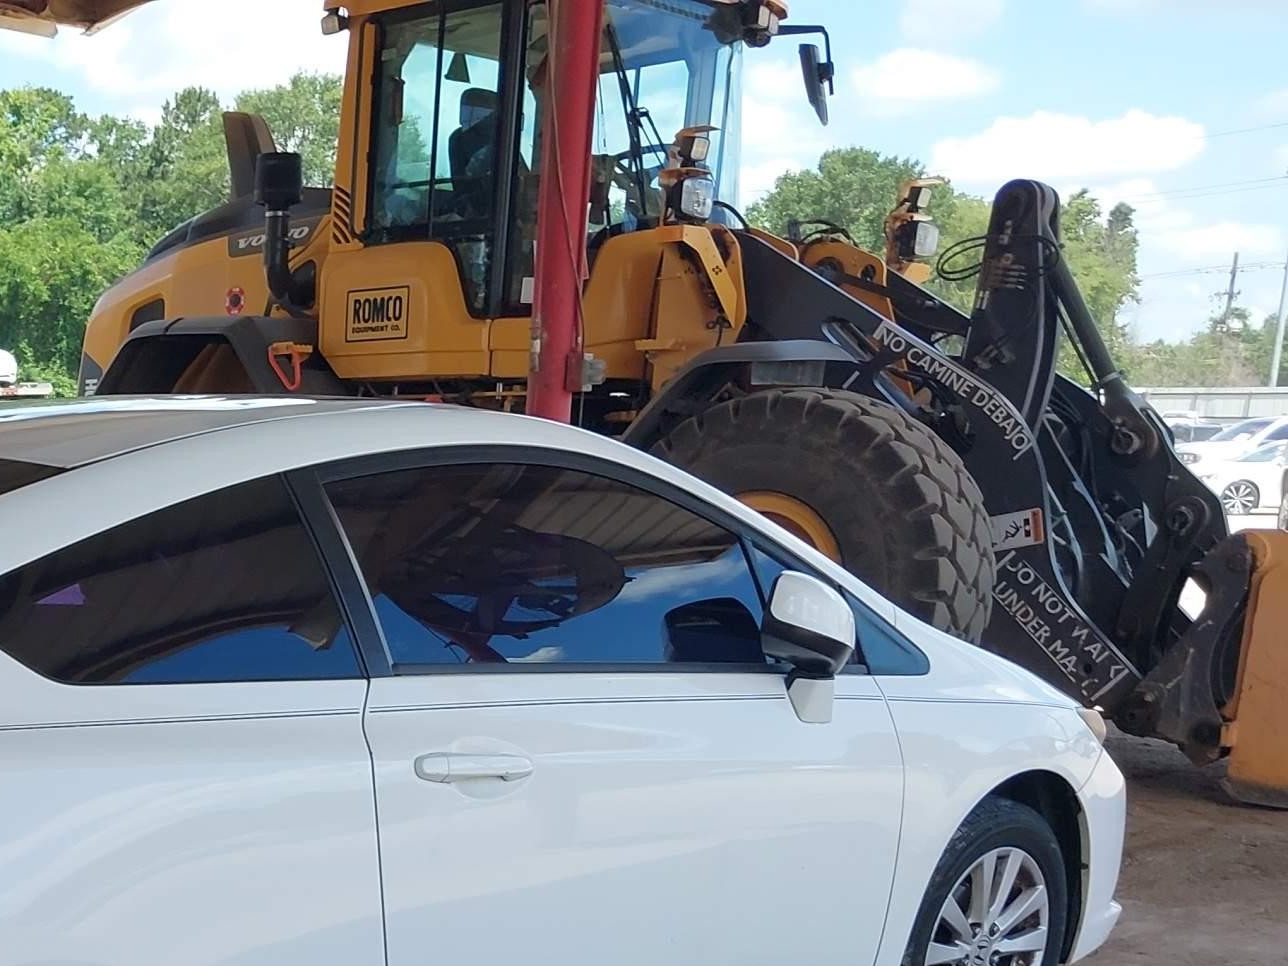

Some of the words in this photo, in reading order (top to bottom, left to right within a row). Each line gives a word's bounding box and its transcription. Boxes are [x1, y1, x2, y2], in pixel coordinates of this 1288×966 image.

[352, 295, 402, 324] ROMCO
[352, 324, 388, 334] EQUIPMENT
[877, 327, 906, 353] NO
[907, 349, 973, 398] CAMINE
[971, 391, 1028, 450] DEBAJO
[995, 581, 1051, 643] UNDER
[1032, 582, 1076, 623] NOT
